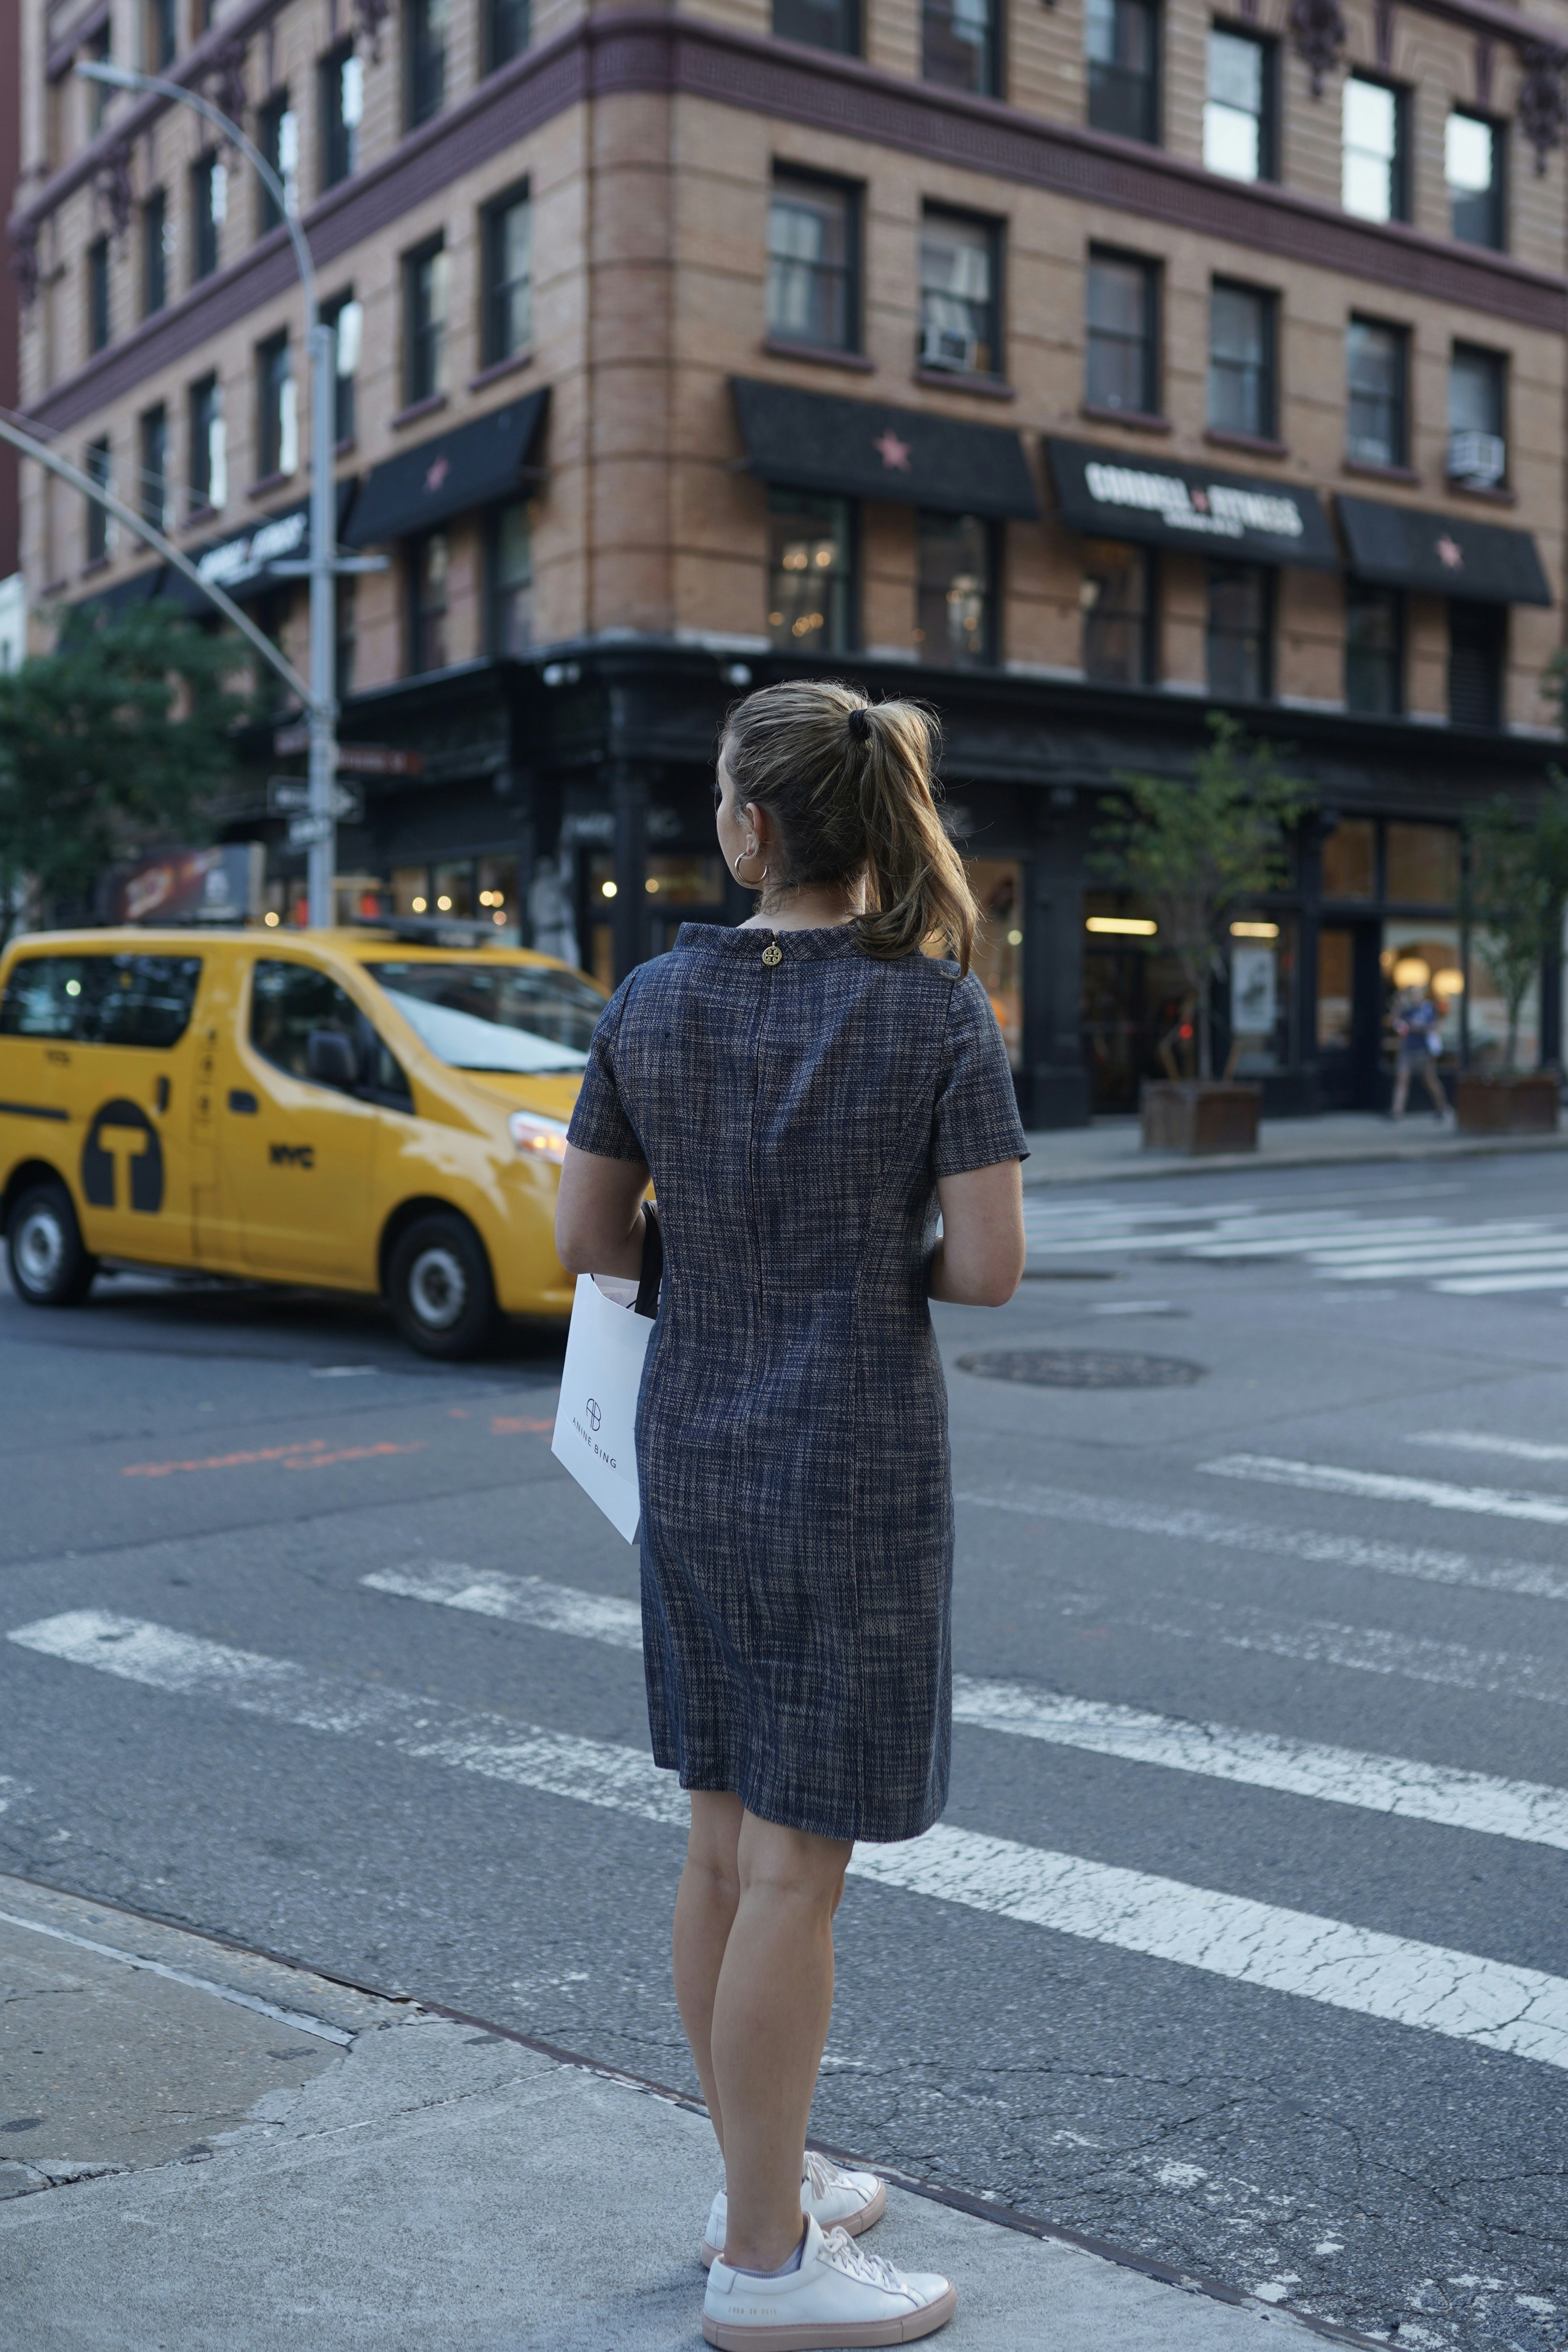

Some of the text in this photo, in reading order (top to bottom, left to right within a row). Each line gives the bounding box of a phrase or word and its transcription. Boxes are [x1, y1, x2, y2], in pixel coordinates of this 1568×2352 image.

[99, 1126, 149, 1211] T
[269, 1144, 314, 1169] NYC
[572, 1417, 617, 1468] ANINE BING
